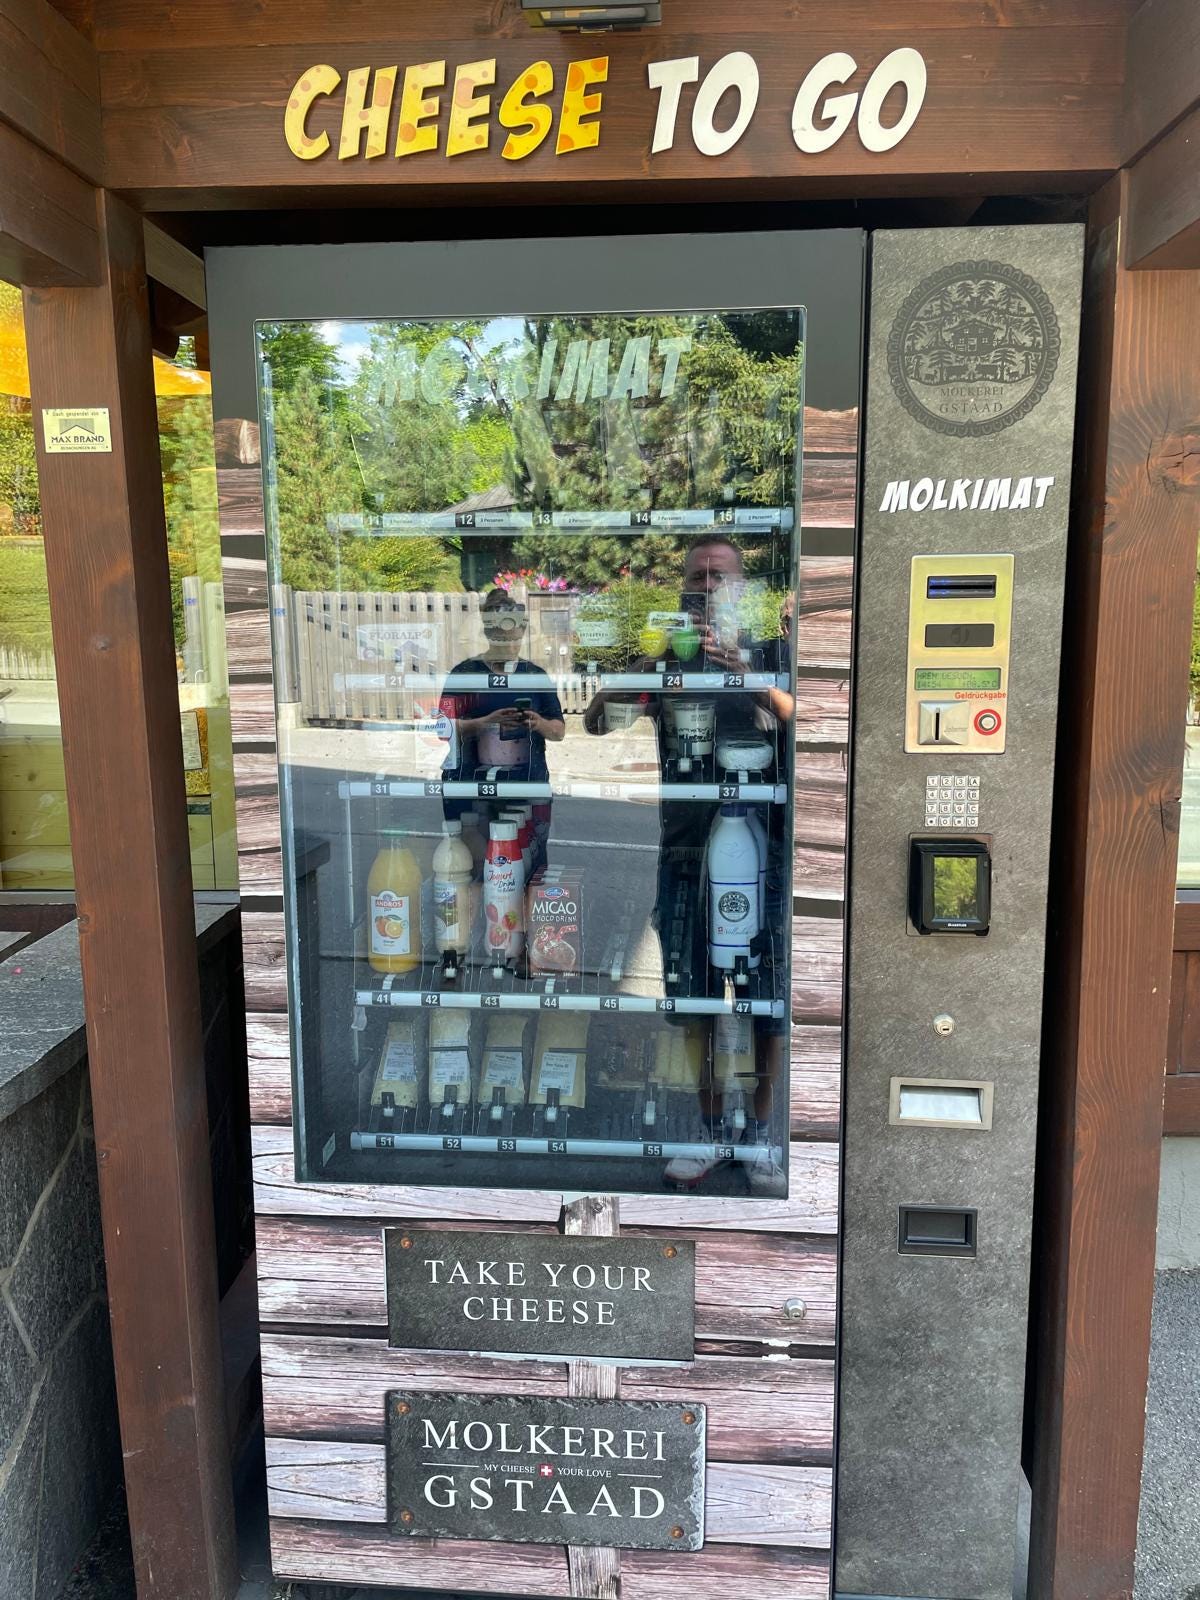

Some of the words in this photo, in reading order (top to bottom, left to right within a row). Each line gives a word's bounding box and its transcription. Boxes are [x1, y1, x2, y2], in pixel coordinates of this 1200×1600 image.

[284, 55, 609, 160] CHEESE
[648, 51, 760, 156] TO
[791, 47, 928, 154] GO
[371, 335, 693, 407] MOKIMAT
[940, 386, 1004, 397] MOLKEREI
[940, 402, 1003, 413] GSTAAD
[51, 435, 71, 443] MAX
[73, 435, 105, 443] BRAND
[878, 475, 1056, 513] MOLKIMAT
[460, 514, 473, 525] 12
[537, 514, 551, 525] 13
[635, 512, 649, 523] 14
[719, 511, 732, 522] 15
[369, 630, 422, 641] FLORALP
[390, 675, 402, 686] 21
[492, 675, 506, 686] 22
[585, 675, 599, 686] 23
[667, 676, 680, 686] 24
[728, 676, 742, 686] 25
[954, 691, 1007, 700] Geldrückgabe
[375, 784, 387, 794] 31
[428, 783, 441, 794] 32
[482, 784, 495, 795] 33
[555, 785, 569, 796] 34
[604, 785, 618, 796] 35
[722, 786, 736, 797] 37
[498, 879, 516, 889] Drink
[376, 900, 404, 908] ANDROS
[531, 901, 577, 915] MICAO
[531, 914, 554, 922] CHOCO
[555, 914, 577, 922] DRINK
[376, 994, 388, 1004] 41
[425, 994, 438, 1004] 42
[484, 995, 498, 1005] 43
[544, 997, 557, 1007] 44
[604, 998, 617, 1009] 45
[659, 999, 673, 1010] 46
[735, 1002, 749, 1013] 47
[380, 1137, 392, 1146] 51
[447, 1139, 459, 1149] 52
[501, 1140, 514, 1150] 53
[552, 1142, 565, 1152] 54
[647, 1145, 660, 1155] 55
[719, 1148, 732, 1158] 56
[424, 1260, 527, 1286] TAKE
[541, 1263, 656, 1292] YOUR
[463, 1296, 617, 1326] CHEESE
[421, 1419, 667, 1461] MOLKEREI
[484, 1463, 498, 1472] MY
[500, 1464, 536, 1474] CHEESE
[557, 1467, 584, 1476] YOUR
[586, 1468, 612, 1478] LOVE
[423, 1475, 666, 1519] GSTAAD
